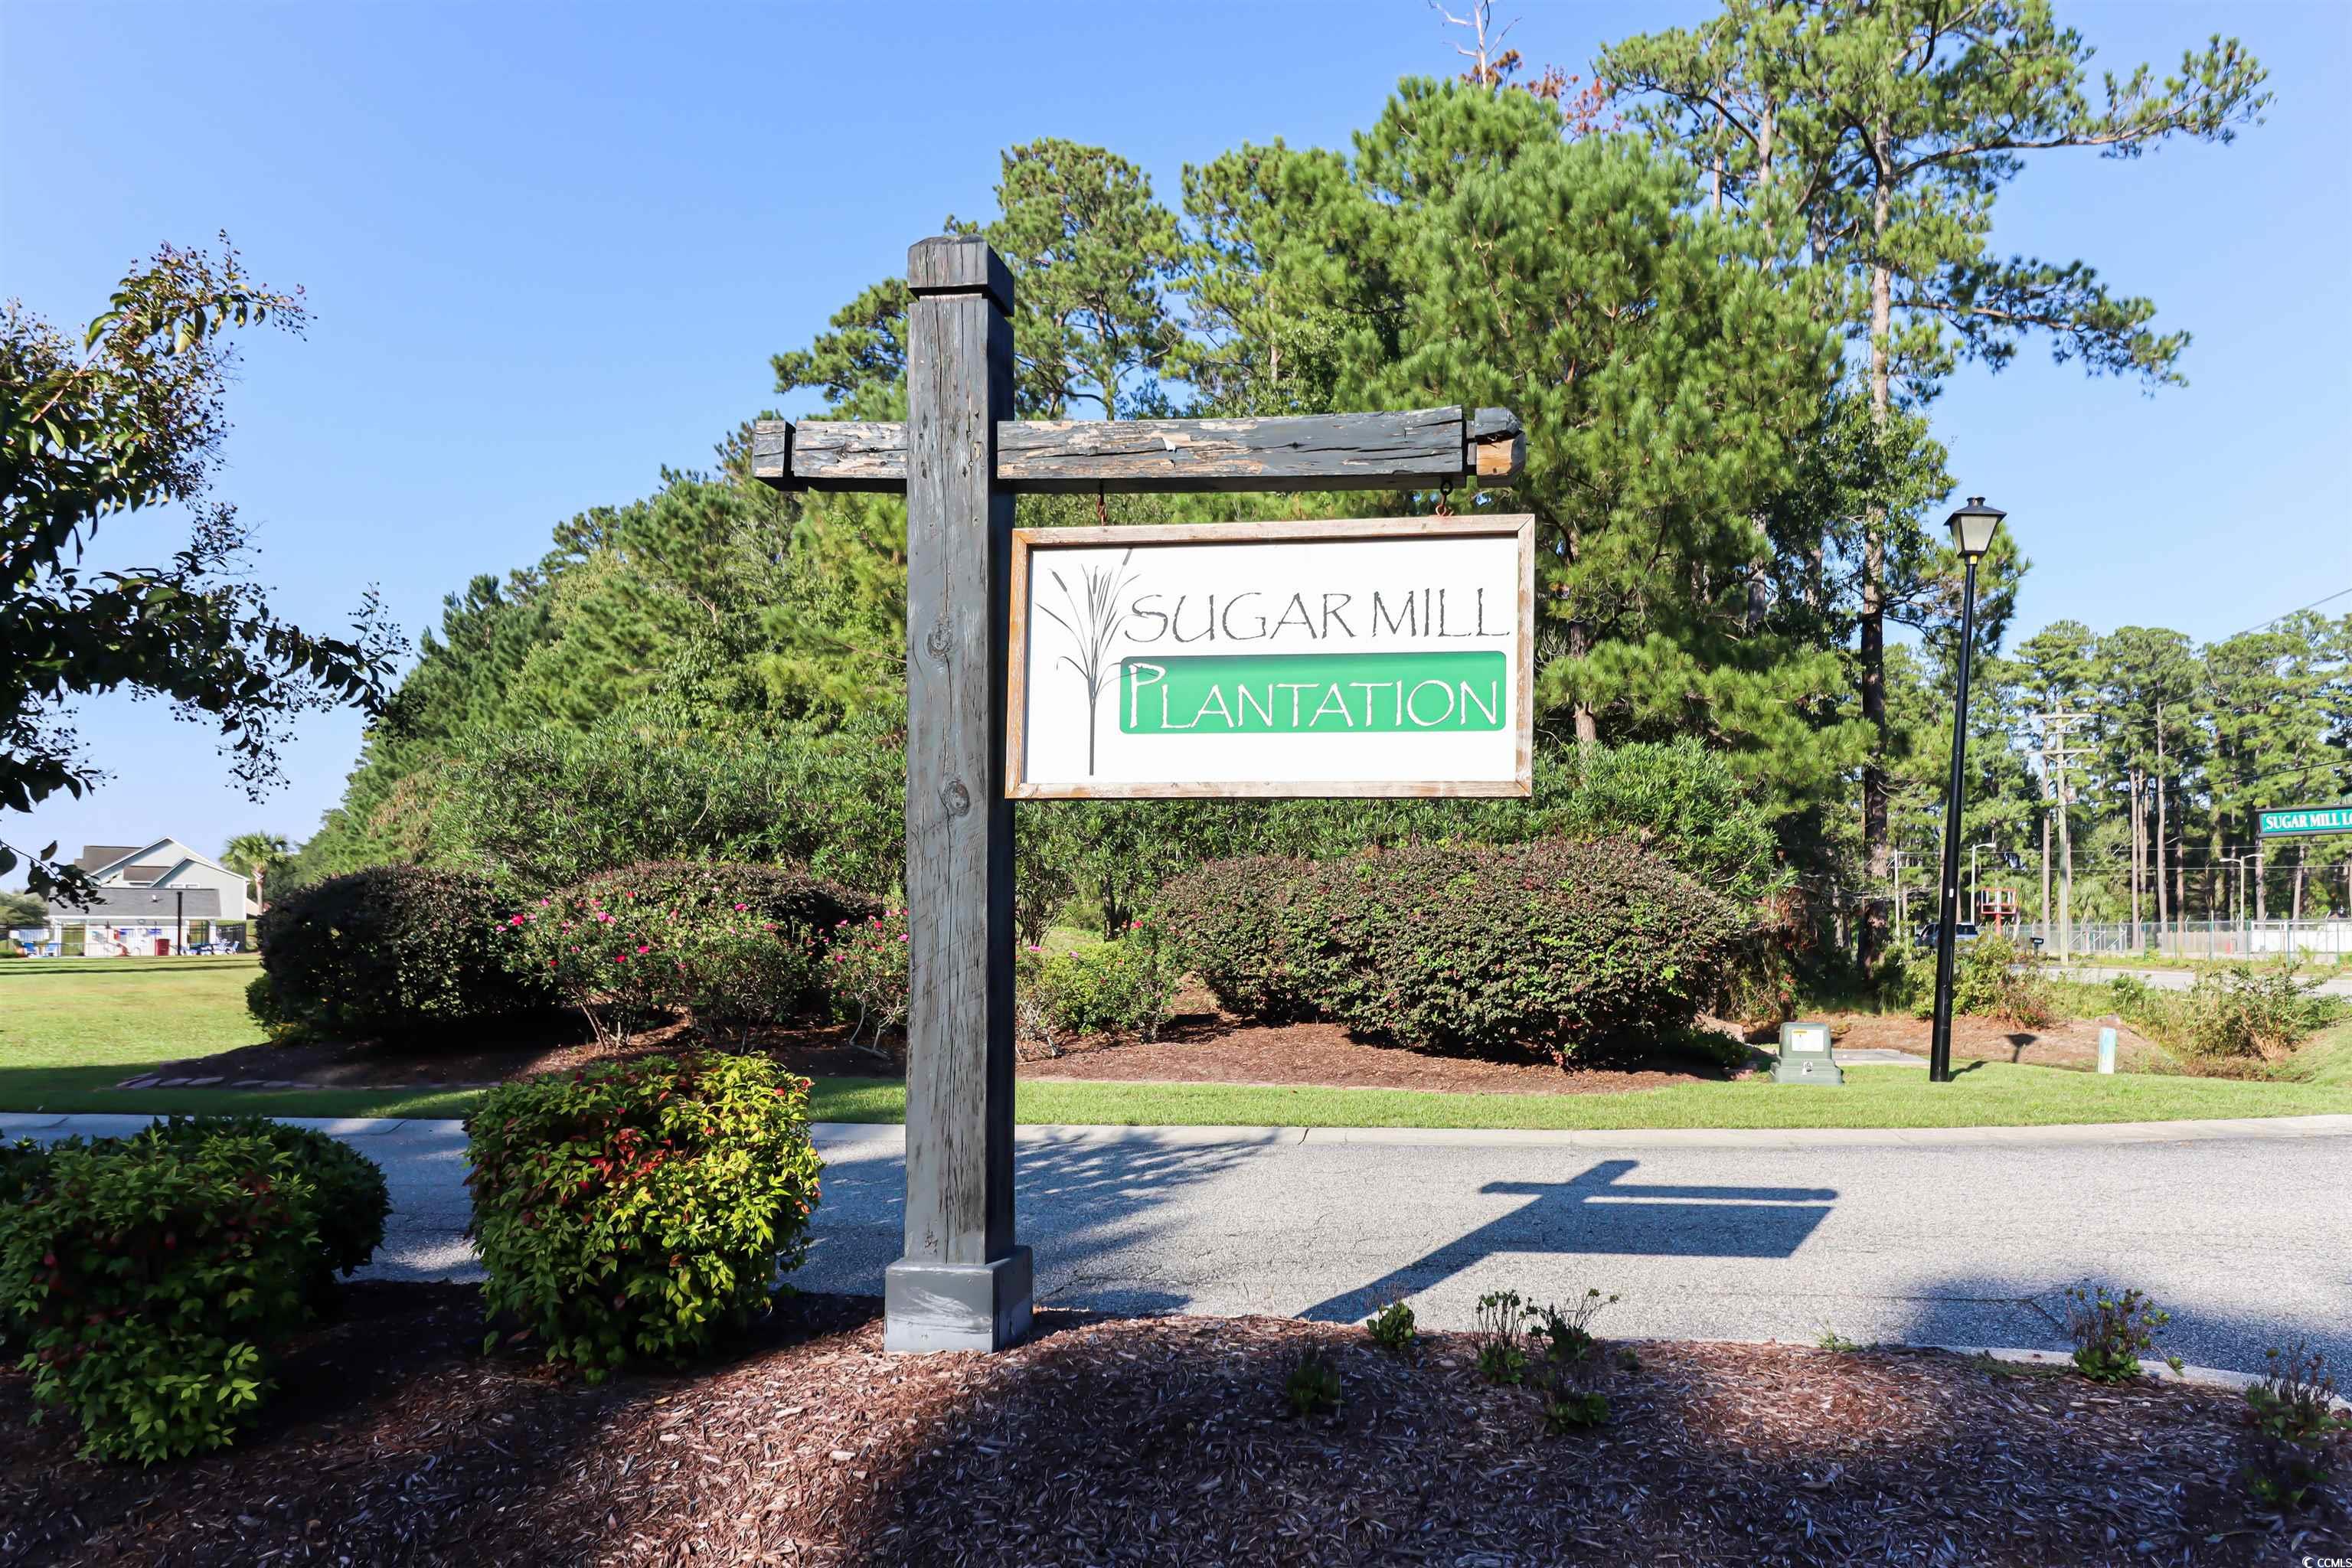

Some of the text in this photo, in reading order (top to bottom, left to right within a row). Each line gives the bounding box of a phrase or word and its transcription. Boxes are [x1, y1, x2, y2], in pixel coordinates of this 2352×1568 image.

[1125, 588, 1510, 642] SUGAR MILL
[2265, 815, 2308, 829] SUGAR
[2309, 812, 2341, 828] MILL
